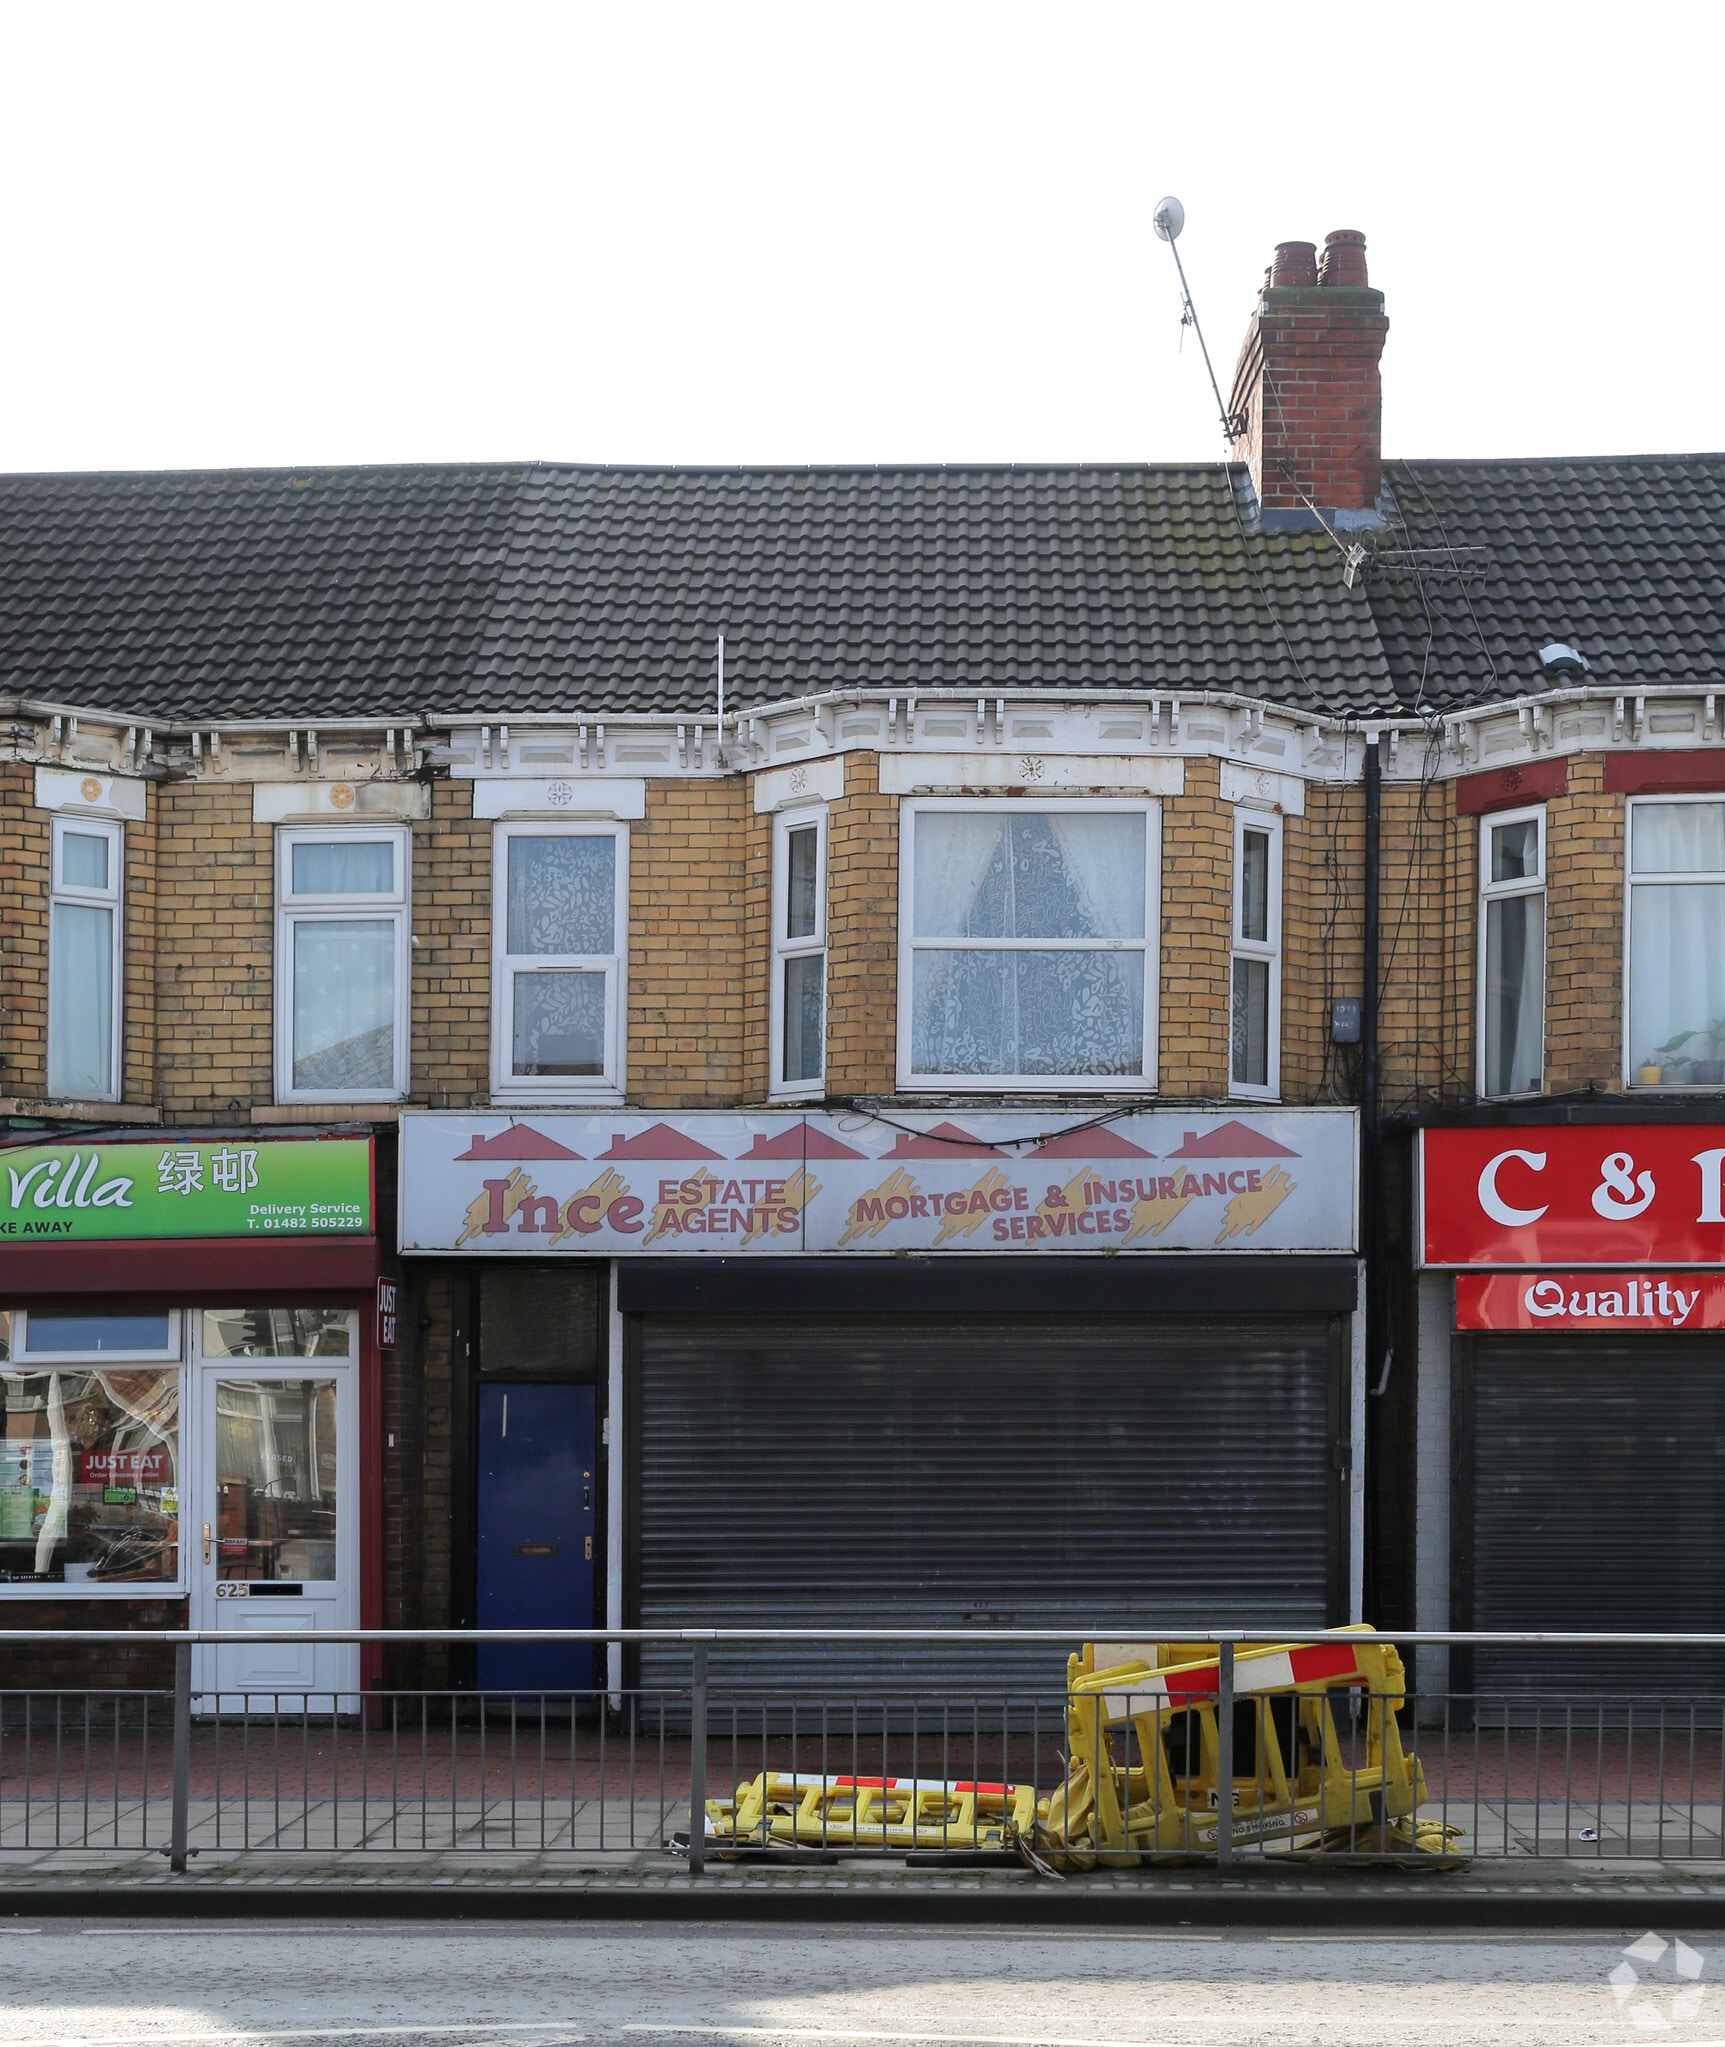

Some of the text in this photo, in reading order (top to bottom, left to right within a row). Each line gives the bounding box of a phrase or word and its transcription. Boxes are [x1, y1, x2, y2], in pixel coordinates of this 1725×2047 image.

[8, 1152, 134, 1209] Villa
[156, 1147, 260, 1196] 绿邨
[856, 1168, 1263, 1222] MORTGAGE & INSURANCE
[1477, 1149, 1550, 1227] C
[1591, 1151, 1656, 1221] &
[250, 1203, 361, 1217] Delivery Service
[481, 1179, 787, 1234] Ince ESTATE
[658, 1206, 801, 1233] AGENTS
[23, 1221, 73, 1234] AWAY
[247, 1217, 363, 1229] T. 01482 505229
[993, 1208, 1131, 1242] SERVICES
[380, 1284, 396, 1314] JUST
[1524, 1280, 1701, 1326] Quality
[383, 1315, 396, 1344] EAT
[85, 1454, 163, 1470] JUST EAT
[260, 1453, 293, 1463] CLOSED
[216, 1583, 249, 1597] 625
[1232, 1826, 1245, 1835] NO
